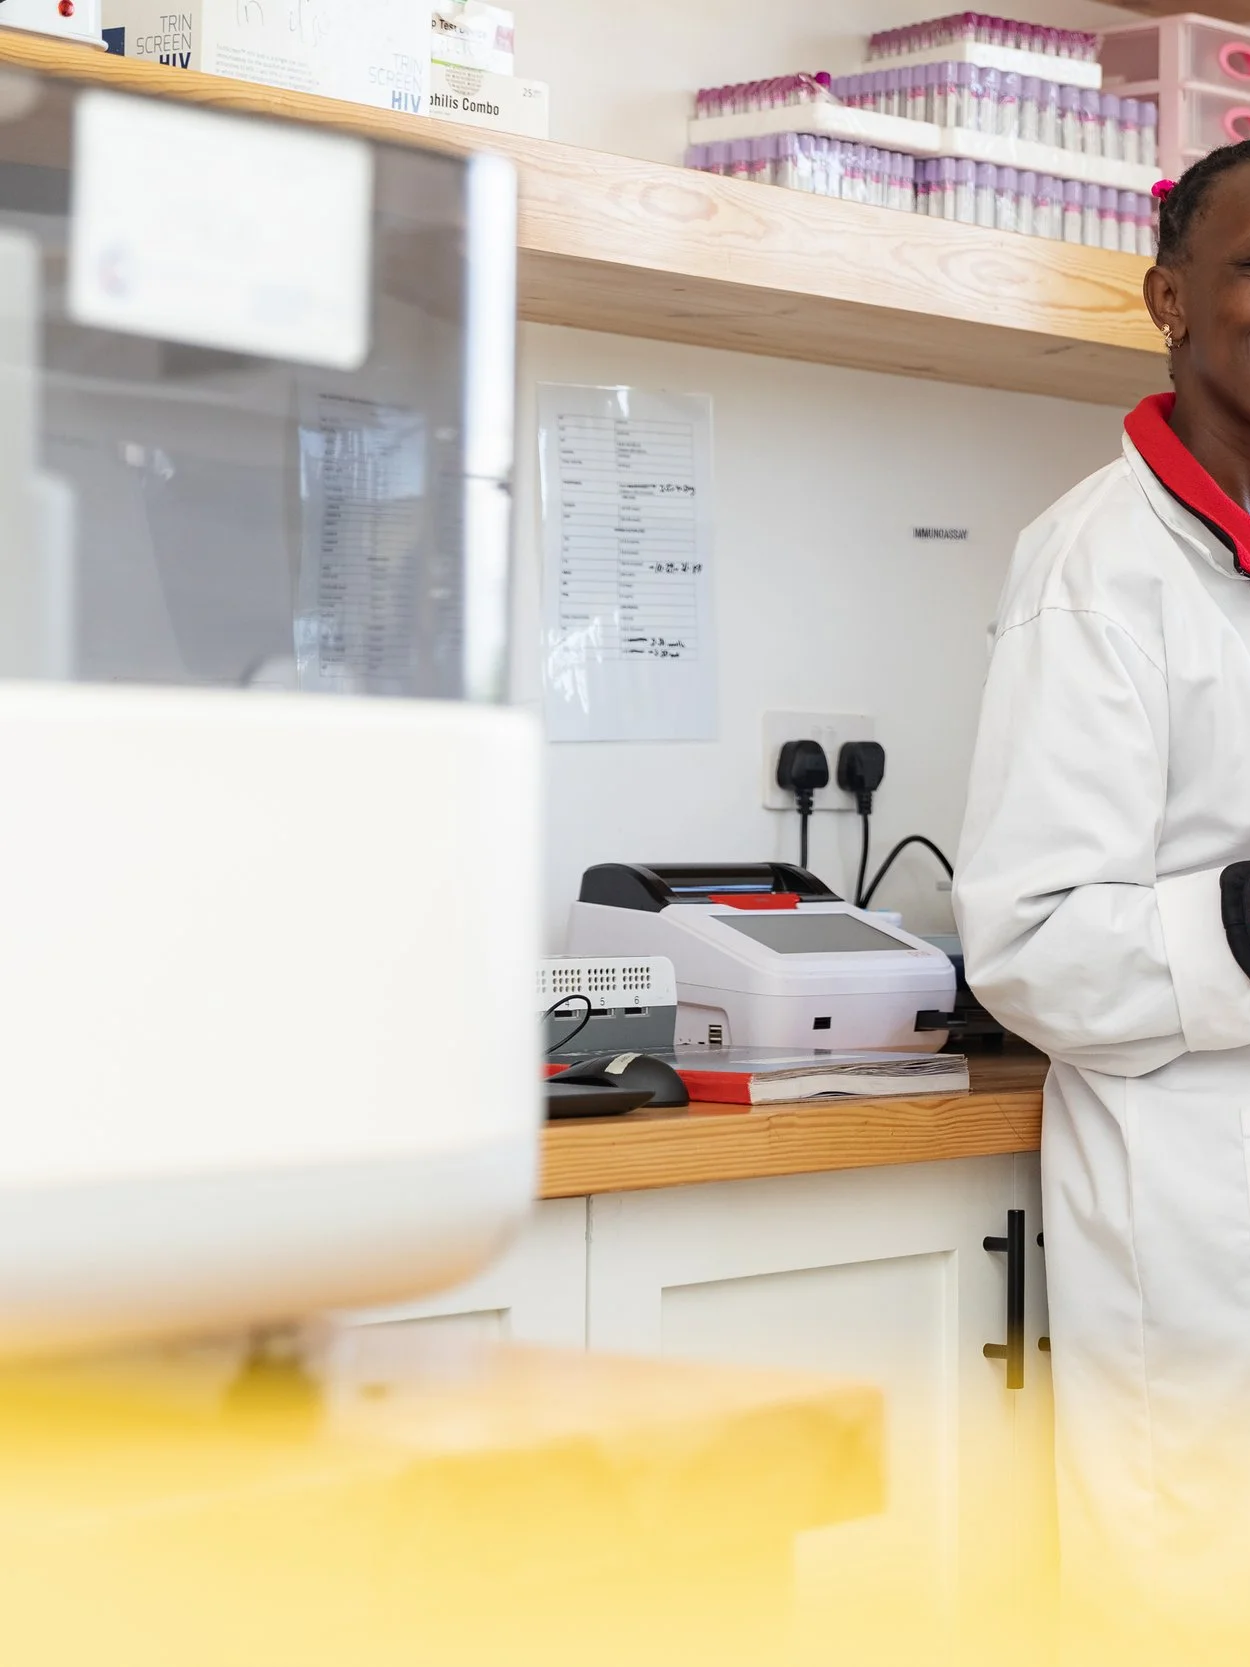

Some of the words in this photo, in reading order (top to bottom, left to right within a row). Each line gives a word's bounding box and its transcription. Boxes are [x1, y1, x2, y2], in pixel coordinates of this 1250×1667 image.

[160, 13, 192, 33] TRIN
[136, 32, 192, 55] SCREEN
[159, 52, 192, 69] HIV
[392, 53, 423, 75] TRIN
[368, 66, 422, 92] SCREEN
[392, 90, 421, 113] HIV
[462, 97, 500, 116] Combo
[912, 528, 968, 539] IMMUNOASSAY
[600, 997, 605, 1007] 5
[634, 995, 640, 1005] 6
